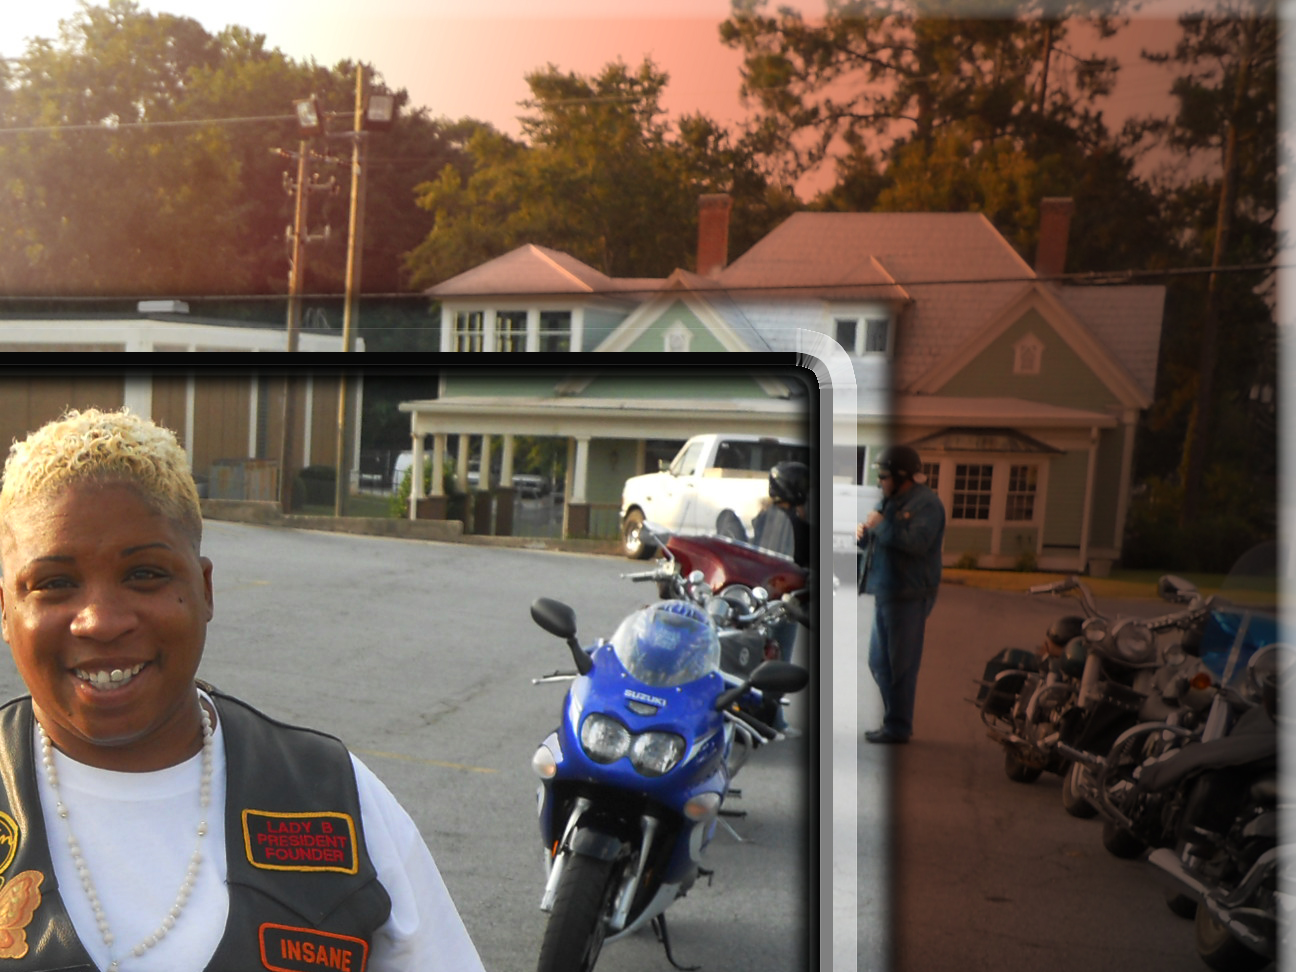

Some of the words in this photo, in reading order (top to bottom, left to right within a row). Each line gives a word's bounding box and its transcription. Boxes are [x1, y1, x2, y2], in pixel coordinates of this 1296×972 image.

[624, 689, 667, 707] SUZUKI
[266, 820, 313, 834] LADY
[322, 822, 334, 834] B
[257, 833, 347, 849] PRESIDENT
[265, 847, 345, 862] FOUNDER
[280, 938, 353, 972] INSANE
